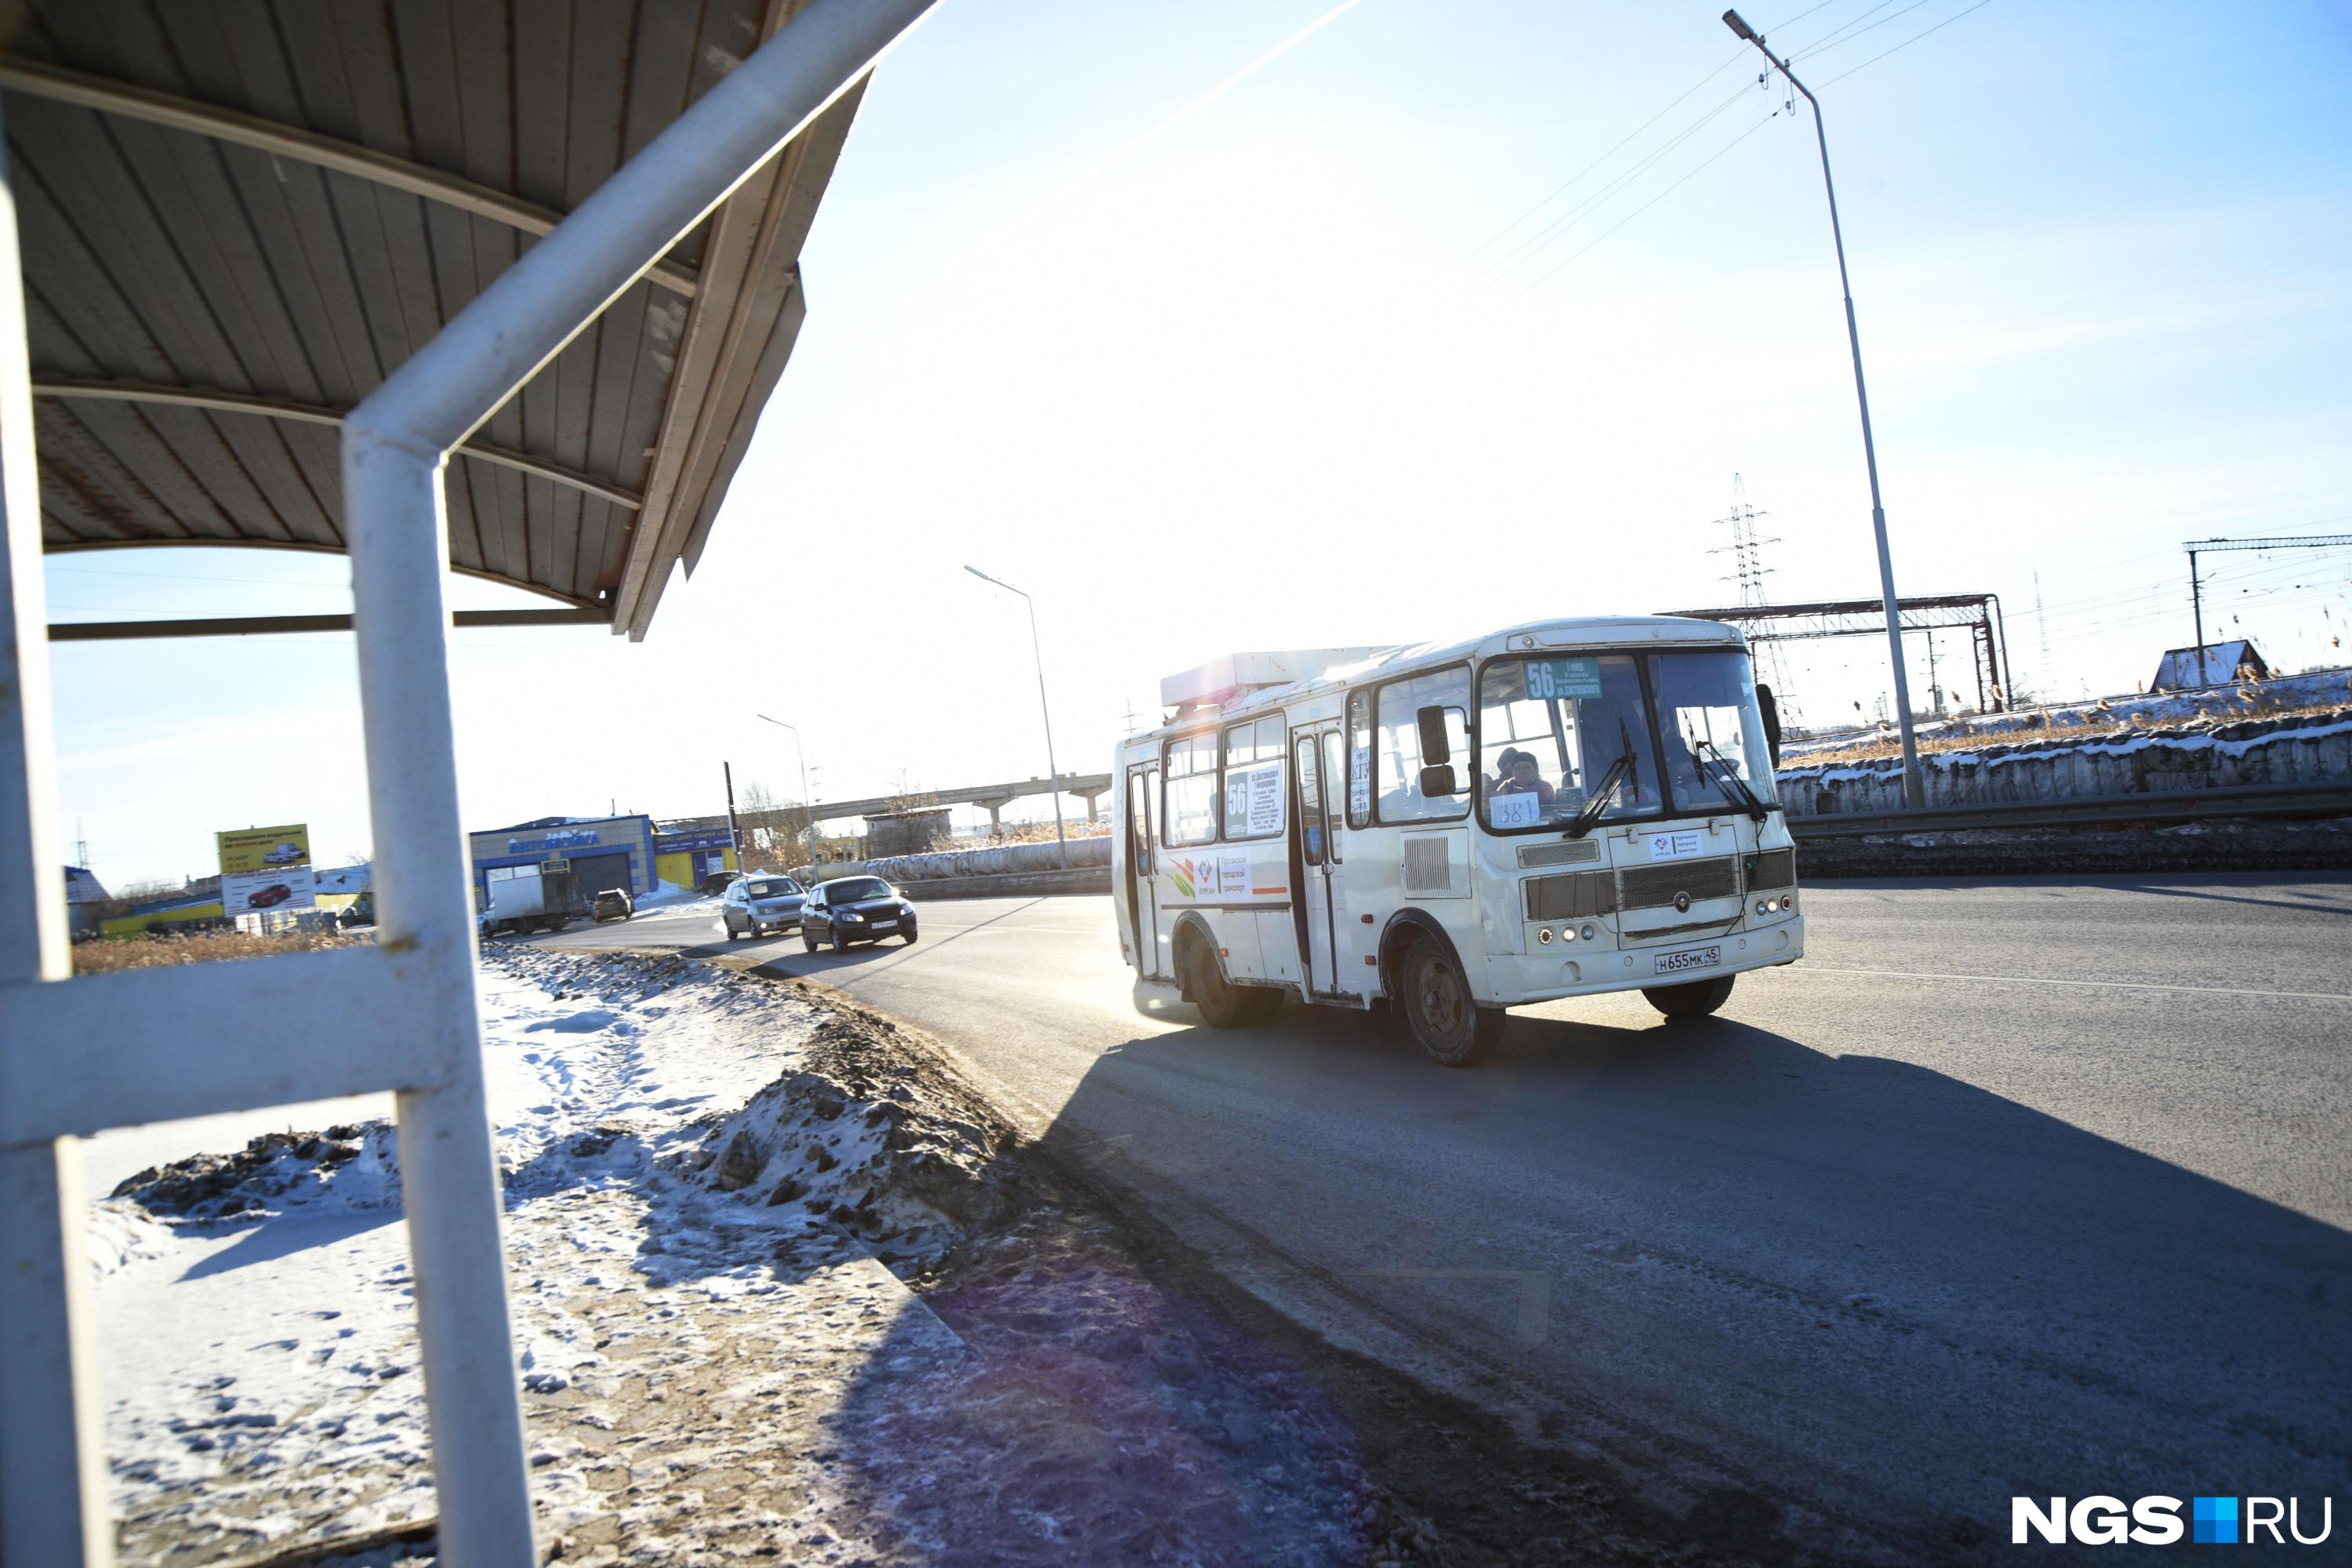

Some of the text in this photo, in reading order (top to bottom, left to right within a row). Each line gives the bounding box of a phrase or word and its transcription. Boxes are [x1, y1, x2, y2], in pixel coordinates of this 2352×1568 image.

[1527, 662, 1555, 698] 56
[1228, 782, 1246, 815] 56
[1500, 799, 1533, 823] 381
[1221, 855, 1247, 866] Курганский
[1221, 868, 1245, 880] городской
[1222, 884, 1245, 894] транспорт
[1660, 953, 1704, 971] Н655МК
